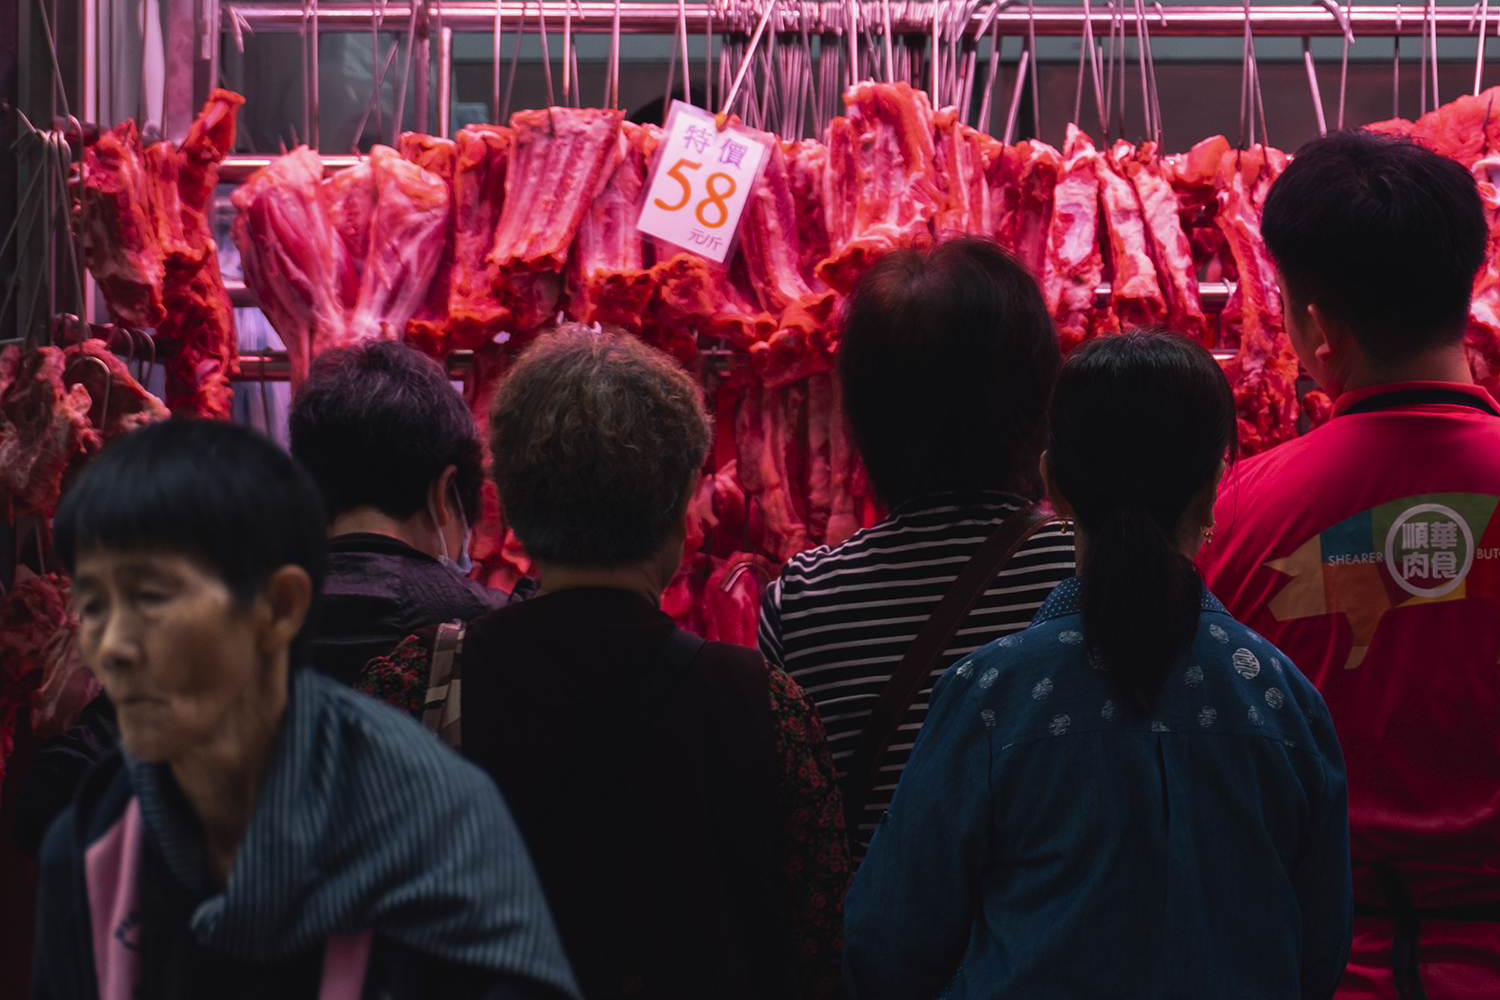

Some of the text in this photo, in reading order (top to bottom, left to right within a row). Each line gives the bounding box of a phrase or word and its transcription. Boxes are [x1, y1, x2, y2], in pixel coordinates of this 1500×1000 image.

[684, 125, 748, 170] 特價
[654, 158, 737, 229] 58
[687, 228, 723, 251] 元/斤
[1401, 521, 1458, 549] 順華
[1328, 551, 1384, 567] SHEARER
[1401, 551, 1458, 580] 肉食
